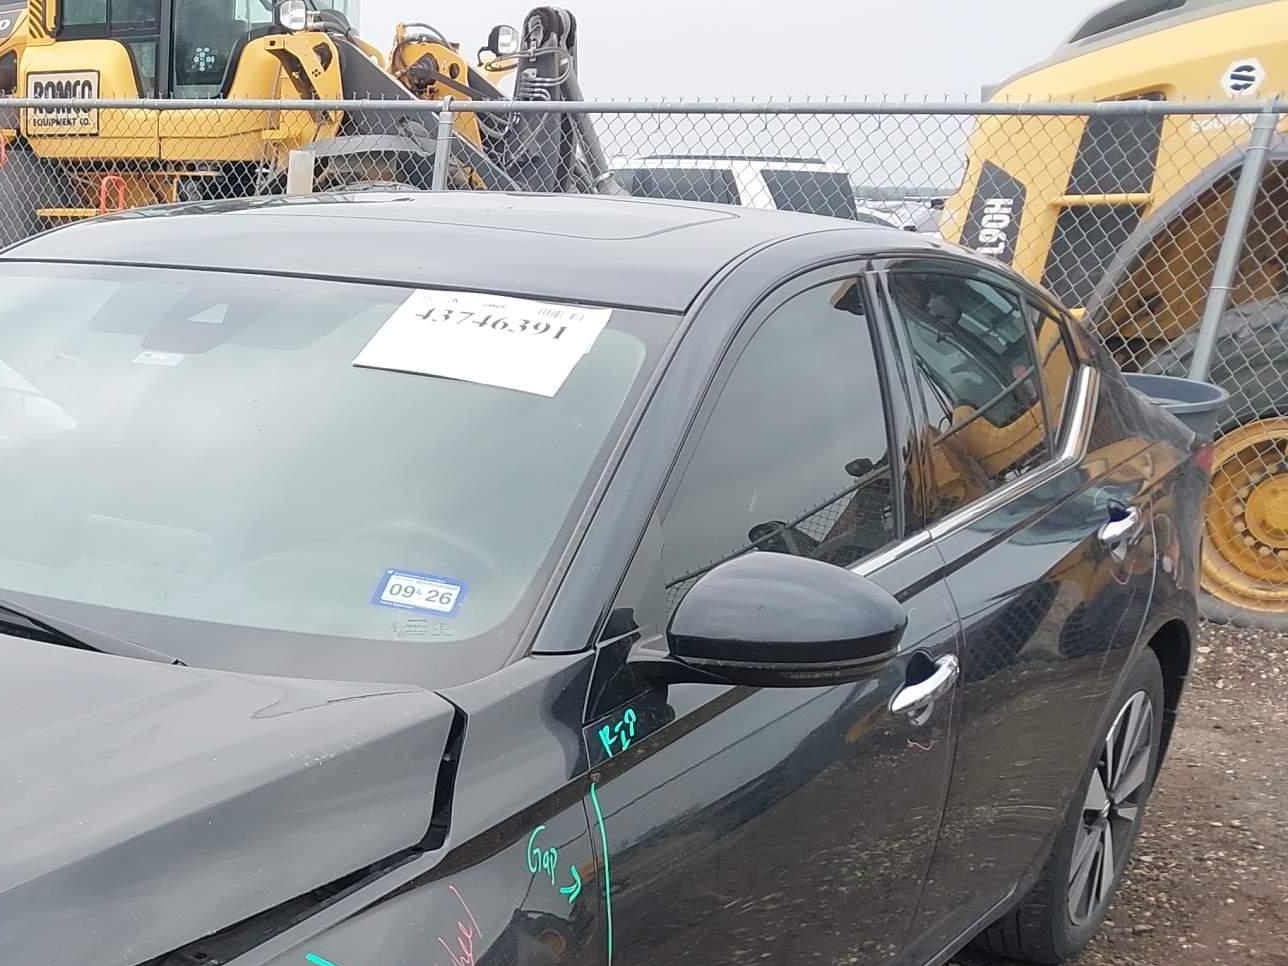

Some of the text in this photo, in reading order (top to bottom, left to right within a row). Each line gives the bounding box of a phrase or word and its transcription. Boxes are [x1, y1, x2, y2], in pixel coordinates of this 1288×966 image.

[33, 79, 93, 114] ROMCO
[33, 117, 78, 127] EQUIPMENT
[976, 198, 1013, 254] L90H
[414, 307, 568, 340] 43746391
[388, 583, 416, 599] 09
[425, 589, 453, 605] 26
